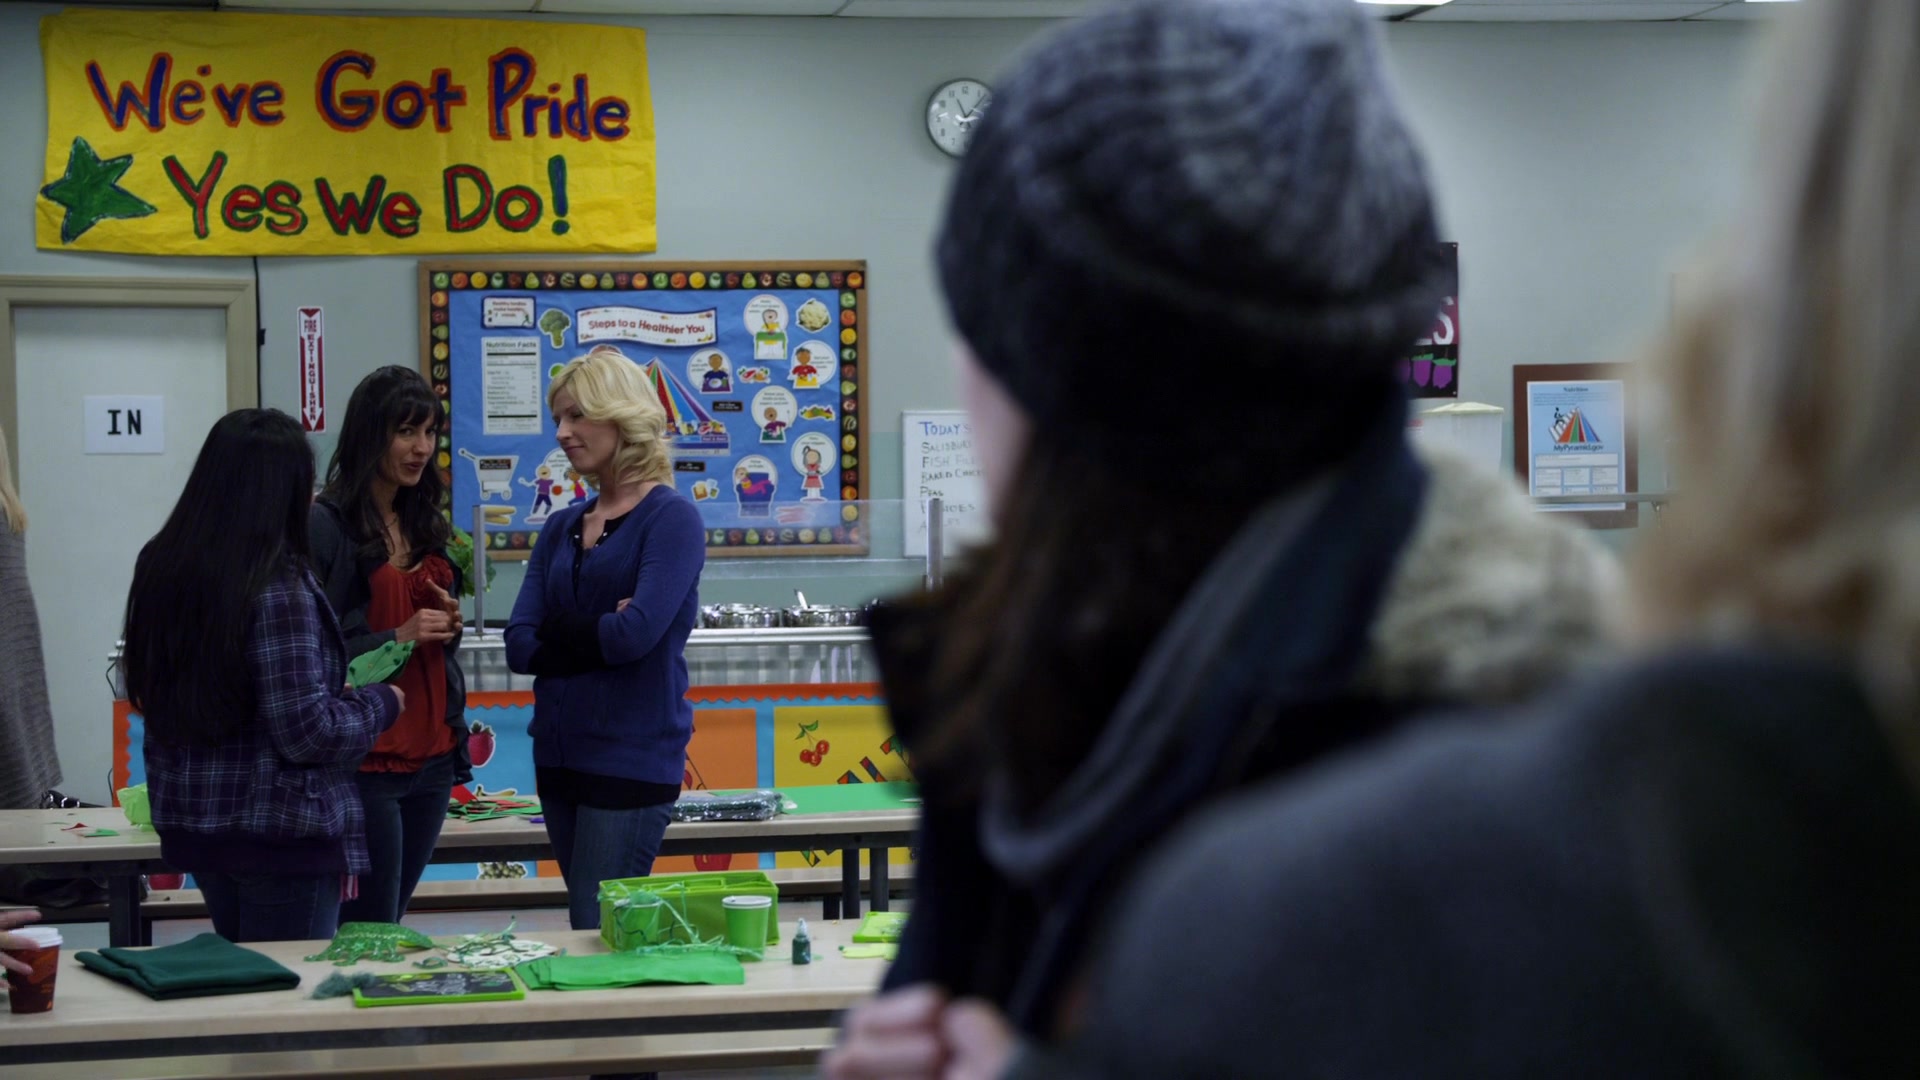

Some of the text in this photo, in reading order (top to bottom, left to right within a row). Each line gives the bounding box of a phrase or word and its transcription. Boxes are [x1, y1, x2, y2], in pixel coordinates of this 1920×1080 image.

[86, 46, 631, 141] We've Got Pride
[163, 150, 570, 239] Yes We Do!
[588, 320, 617, 331] Steps
[618, 319, 628, 328] to
[638, 320, 684, 335] Healthier
[686, 324, 705, 334] You
[307, 334, 316, 421] EXTINGUISHER
[107, 409, 142, 435] IN
[1553, 443, 1604, 452] MyPyramid.gov
